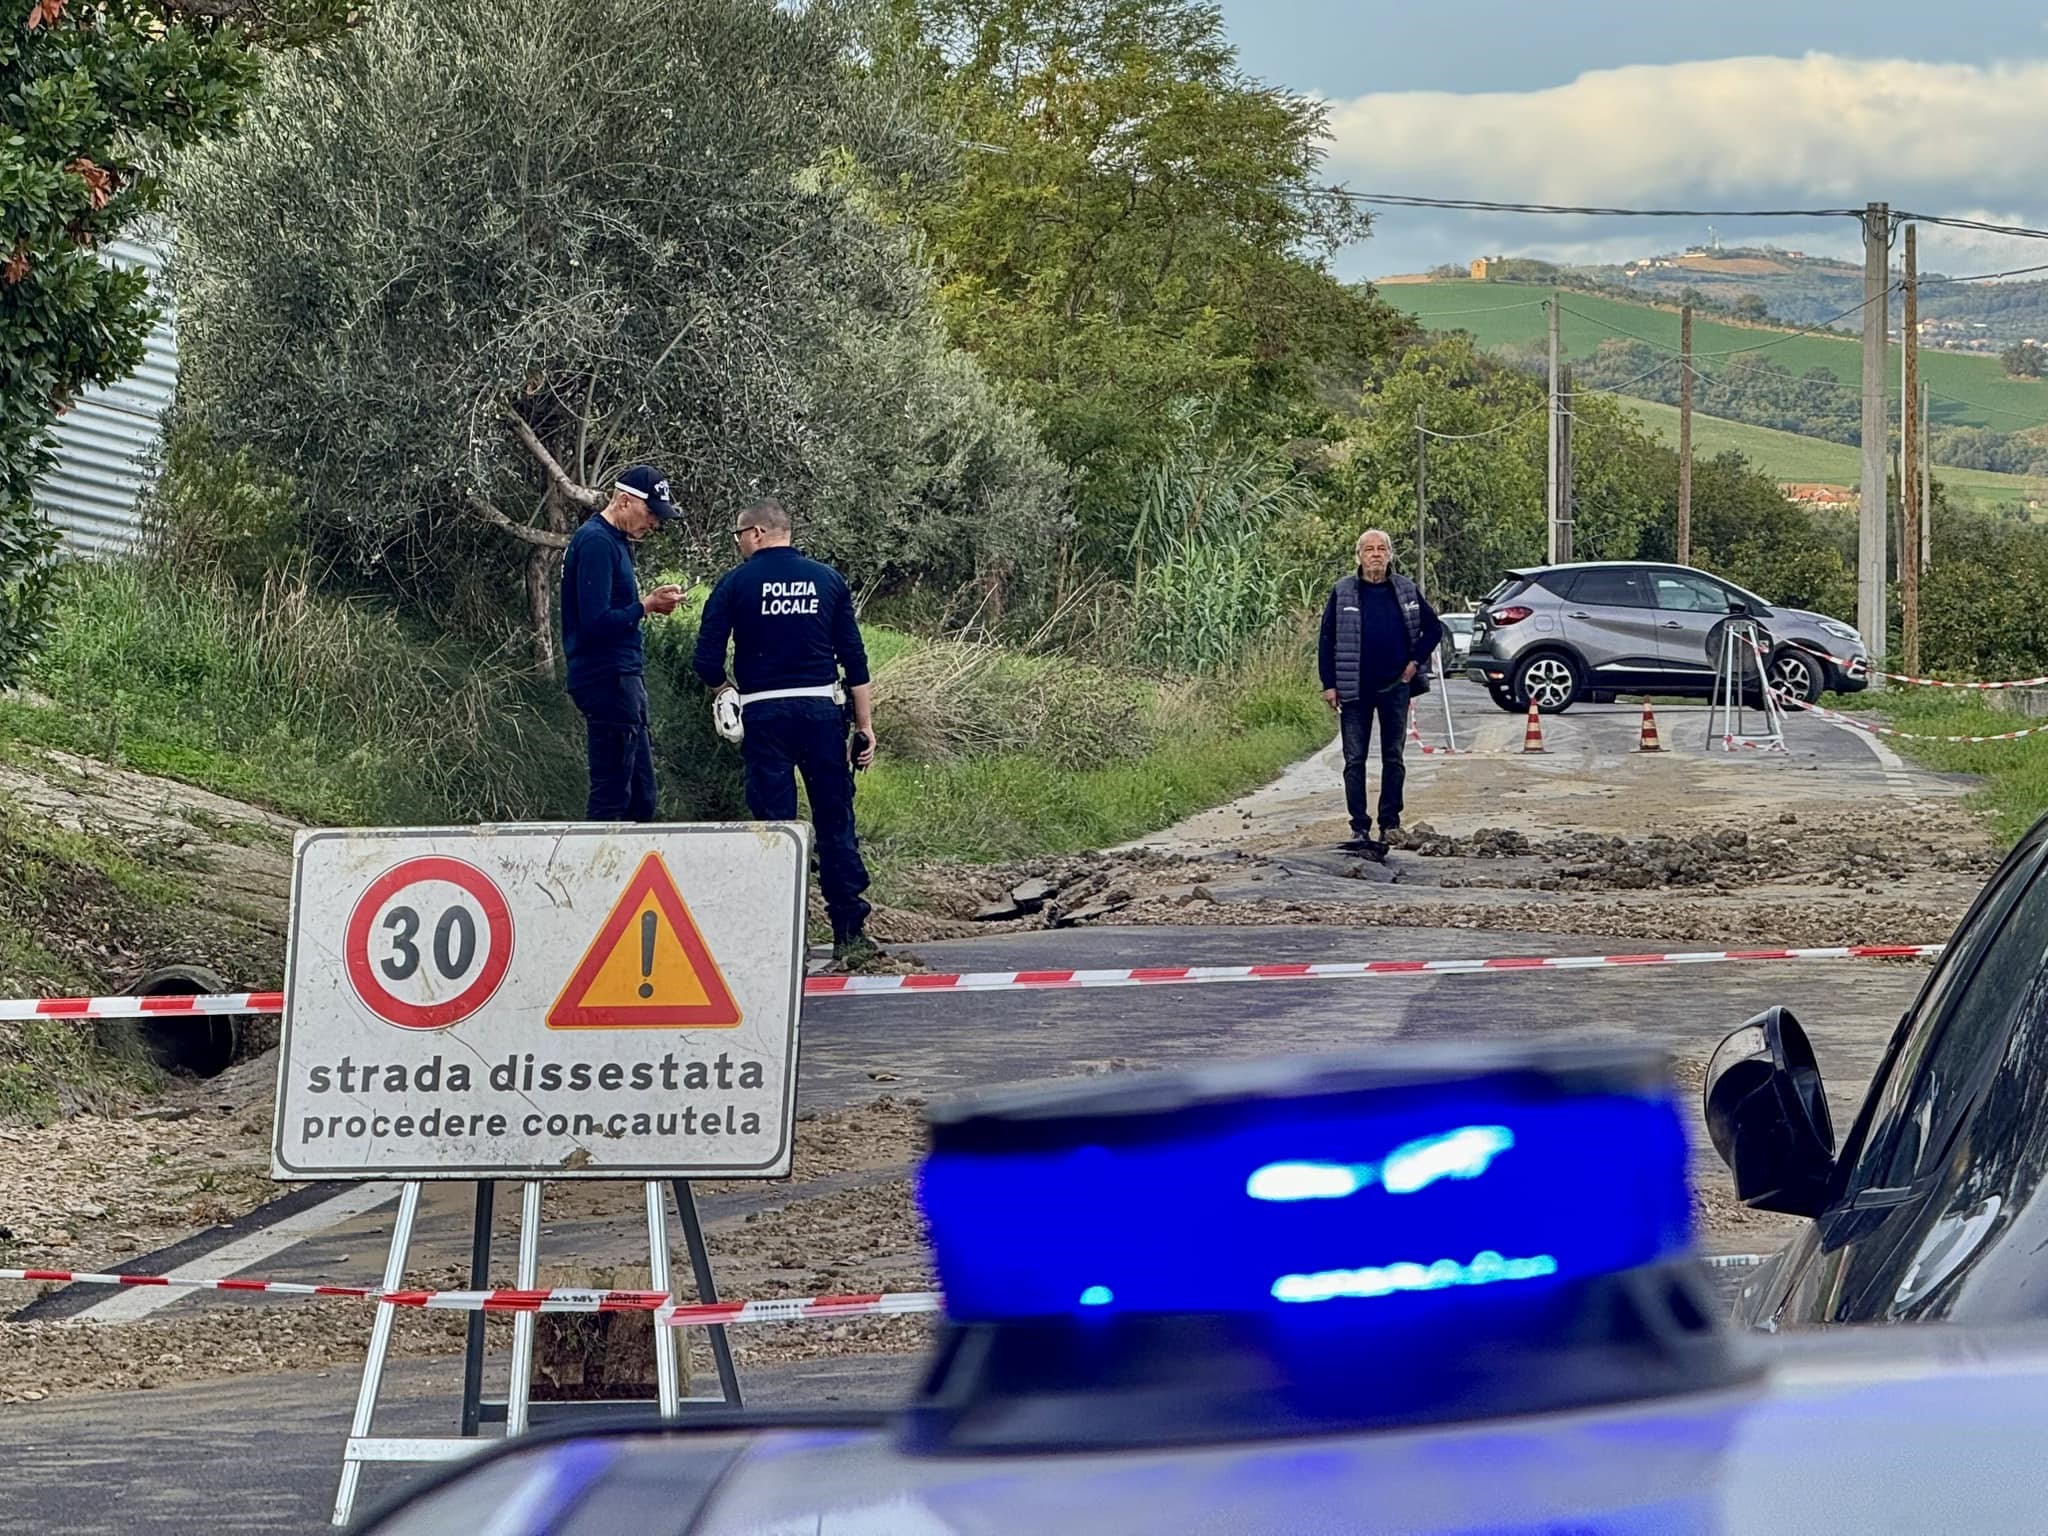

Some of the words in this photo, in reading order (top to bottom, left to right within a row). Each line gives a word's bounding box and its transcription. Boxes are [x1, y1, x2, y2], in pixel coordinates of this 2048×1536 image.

[761, 599, 819, 615] LOCALE
[762, 581, 817, 597] POLIZIA
[380, 905, 477, 981] 30
[307, 1056, 471, 1092] strada
[489, 1053, 764, 1091] dissestata
[302, 1108, 507, 1144] procedere
[522, 1114, 593, 1136] con
[605, 1106, 761, 1136] cautela
